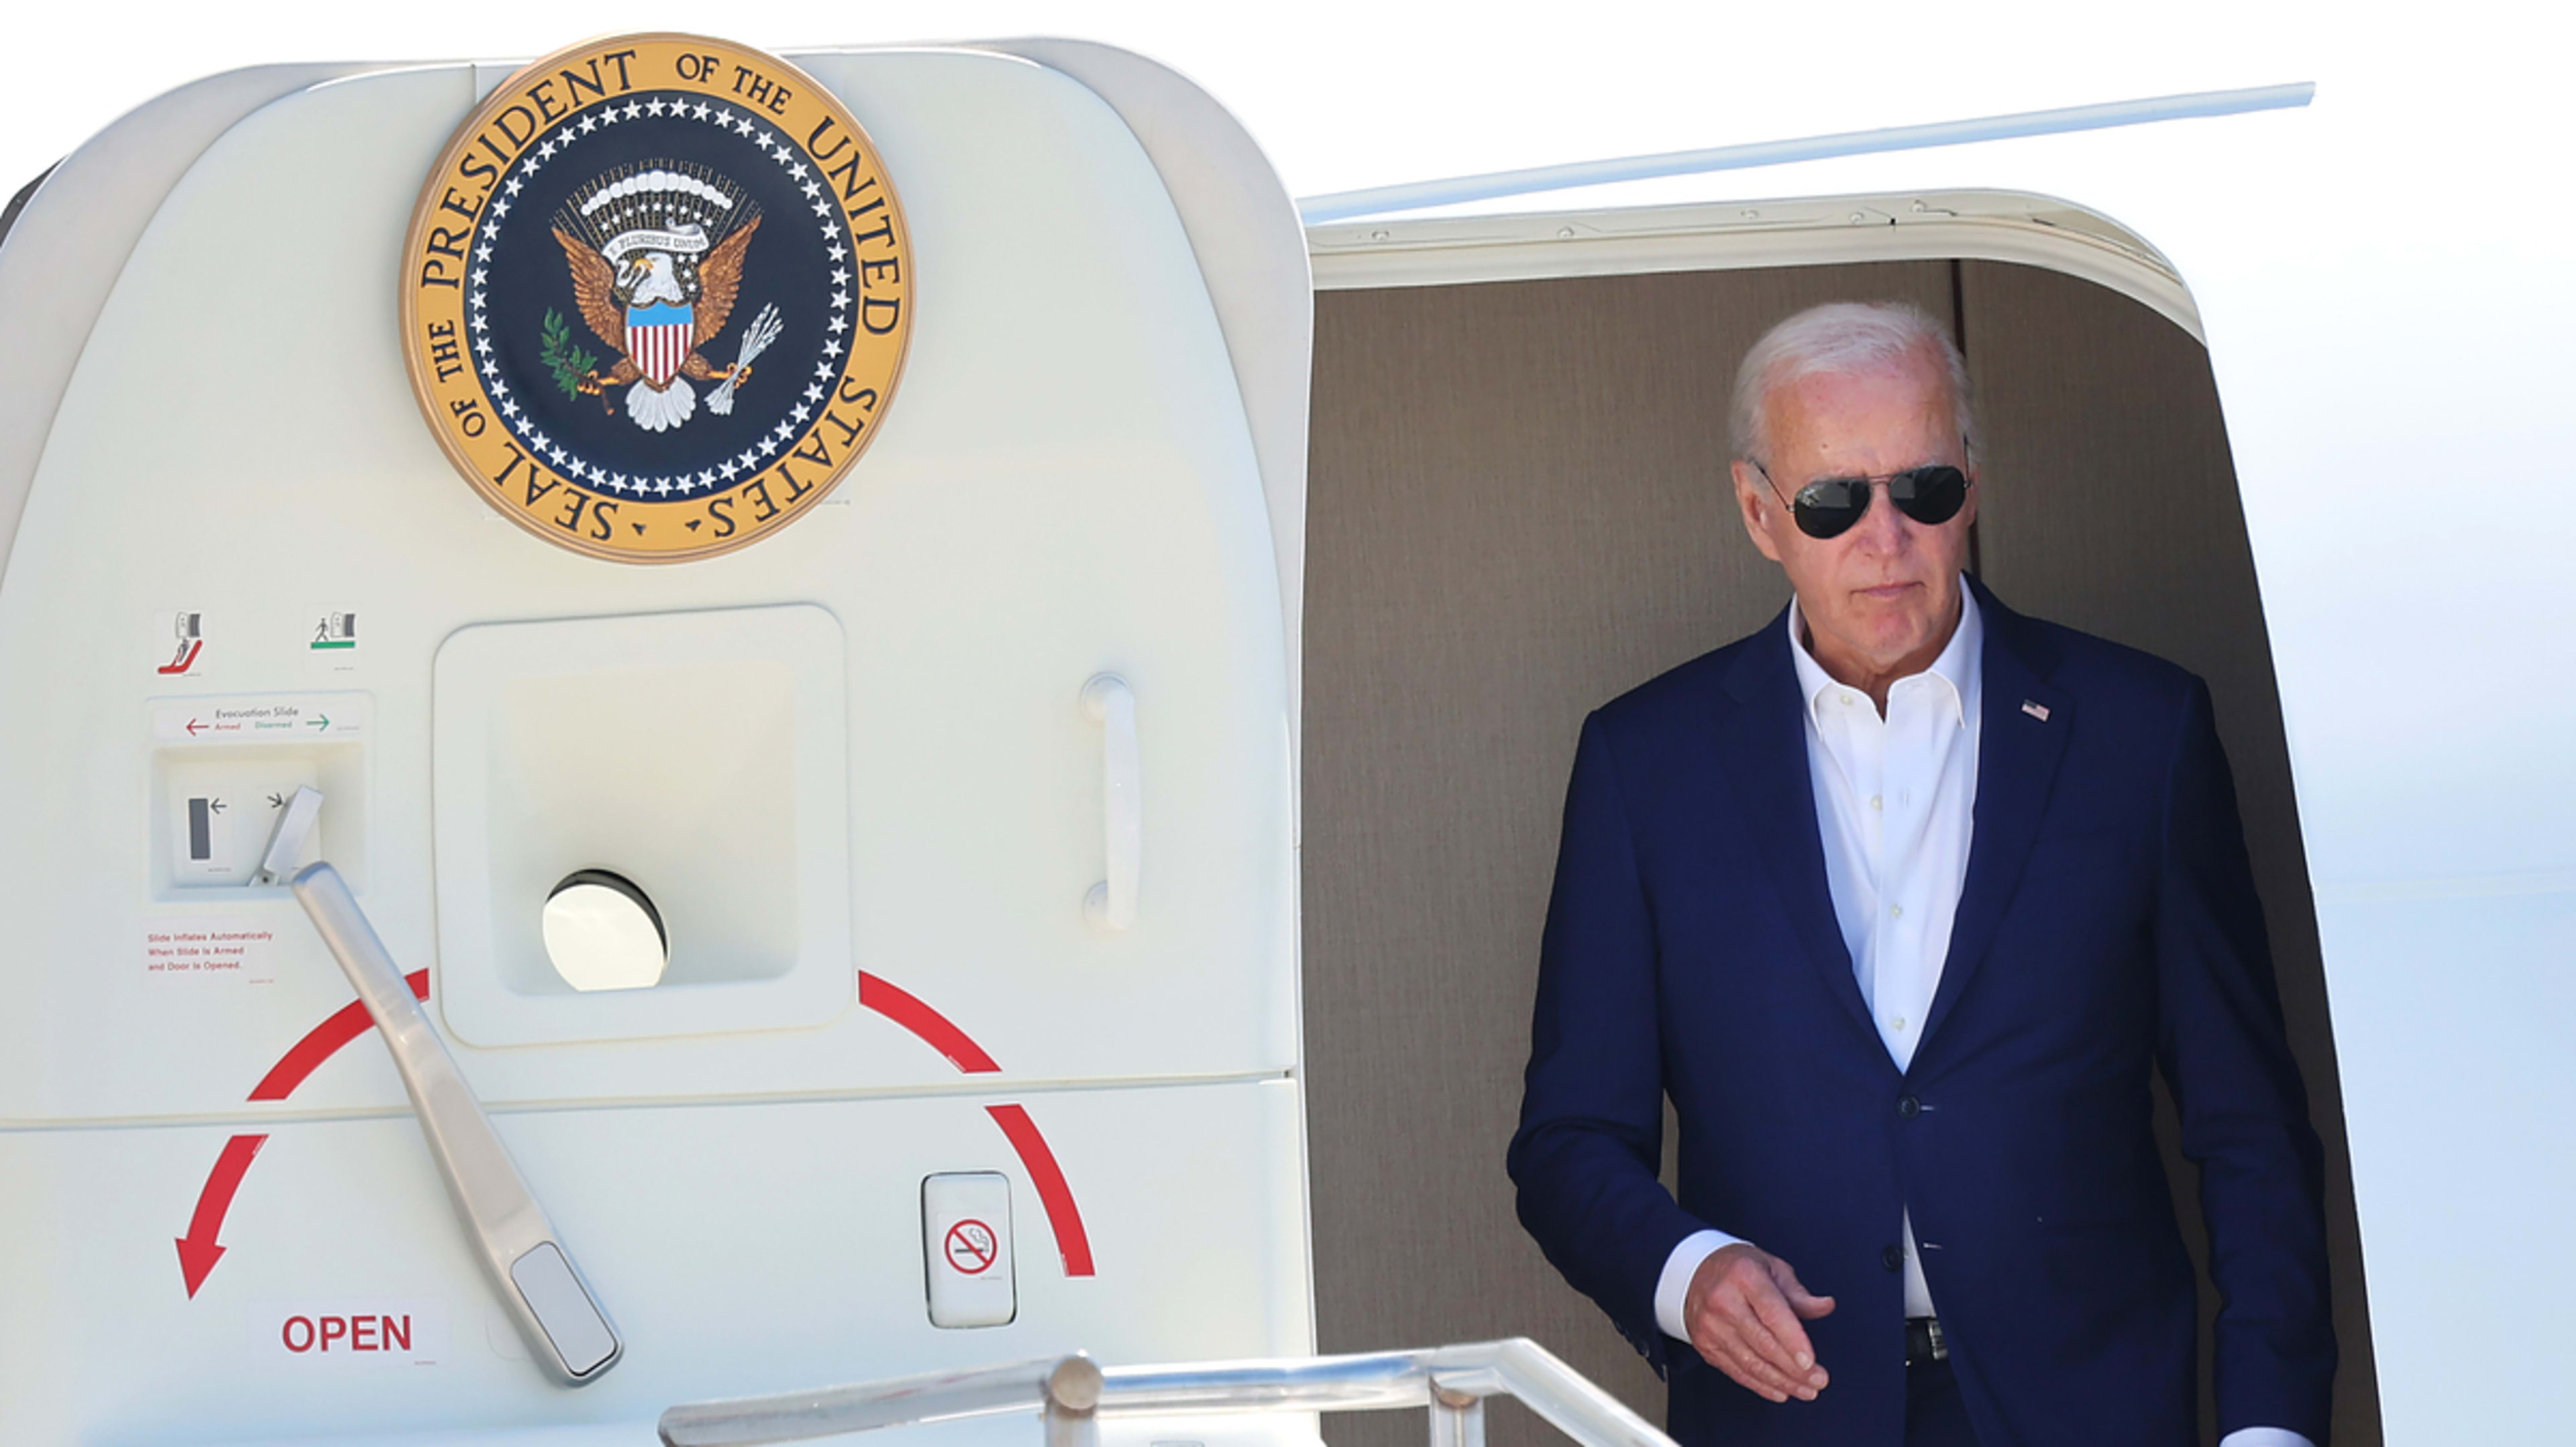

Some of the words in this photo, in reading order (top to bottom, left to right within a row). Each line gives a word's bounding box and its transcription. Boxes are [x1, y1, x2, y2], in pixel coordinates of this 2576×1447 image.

[676, 54, 720, 83] OF
[733, 66, 792, 115] THE
[421, 50, 636, 289] PRESIDENT
[807, 116, 900, 335] UNITED
[428, 319, 464, 382] THE
[451, 398, 486, 437] OF
[708, 376, 877, 537] STATES
[494, 442, 619, 541] SEAL
[215, 708, 271, 718] Evacuation
[274, 706, 299, 717] Slide
[255, 721, 292, 730] Disarmed
[148, 934, 170, 943] Slide
[174, 933, 207, 942] Inflates
[211, 931, 273, 942] Automatically
[148, 948, 174, 957] When
[177, 947, 199, 956] Slide
[214, 946, 244, 955] Armed
[148, 963, 164, 971] and
[167, 962, 190, 971] Door
[282, 1315, 412, 1352] OPEN
